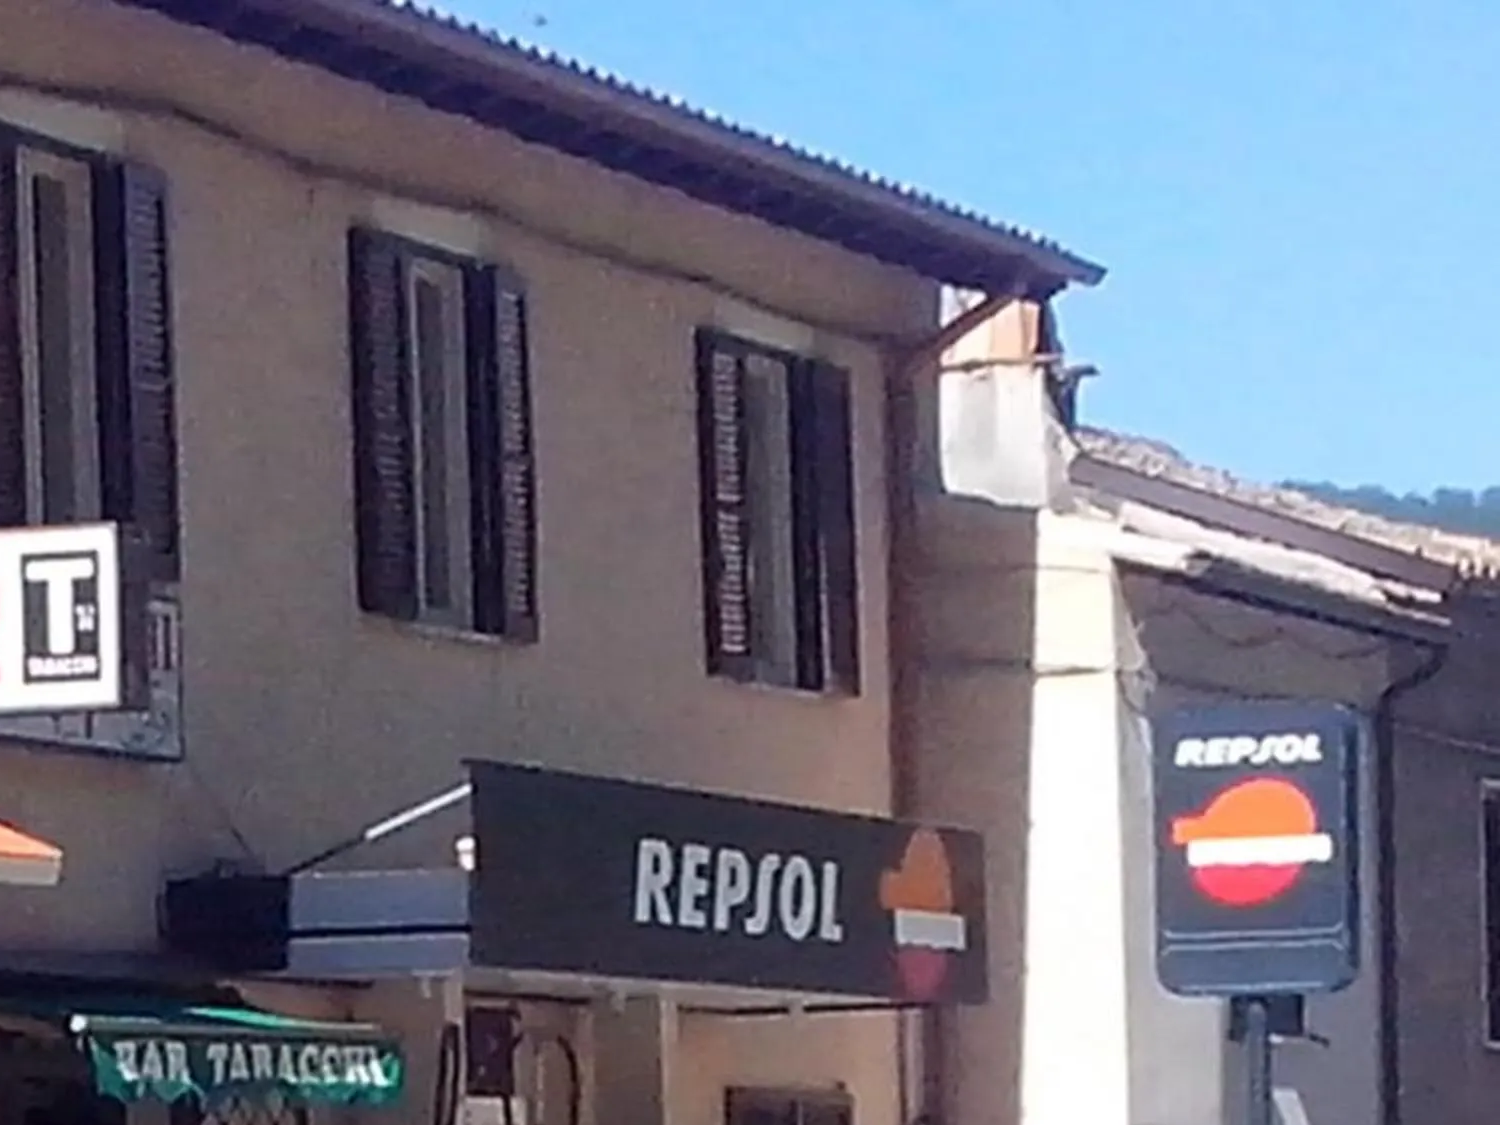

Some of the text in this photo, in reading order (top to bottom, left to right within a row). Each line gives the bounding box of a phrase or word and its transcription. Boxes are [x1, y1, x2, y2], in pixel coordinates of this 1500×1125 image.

[1173, 733, 1323, 767] REPSOL
[633, 837, 844, 943] REPSOL
[112, 1038, 193, 1085] BAR
